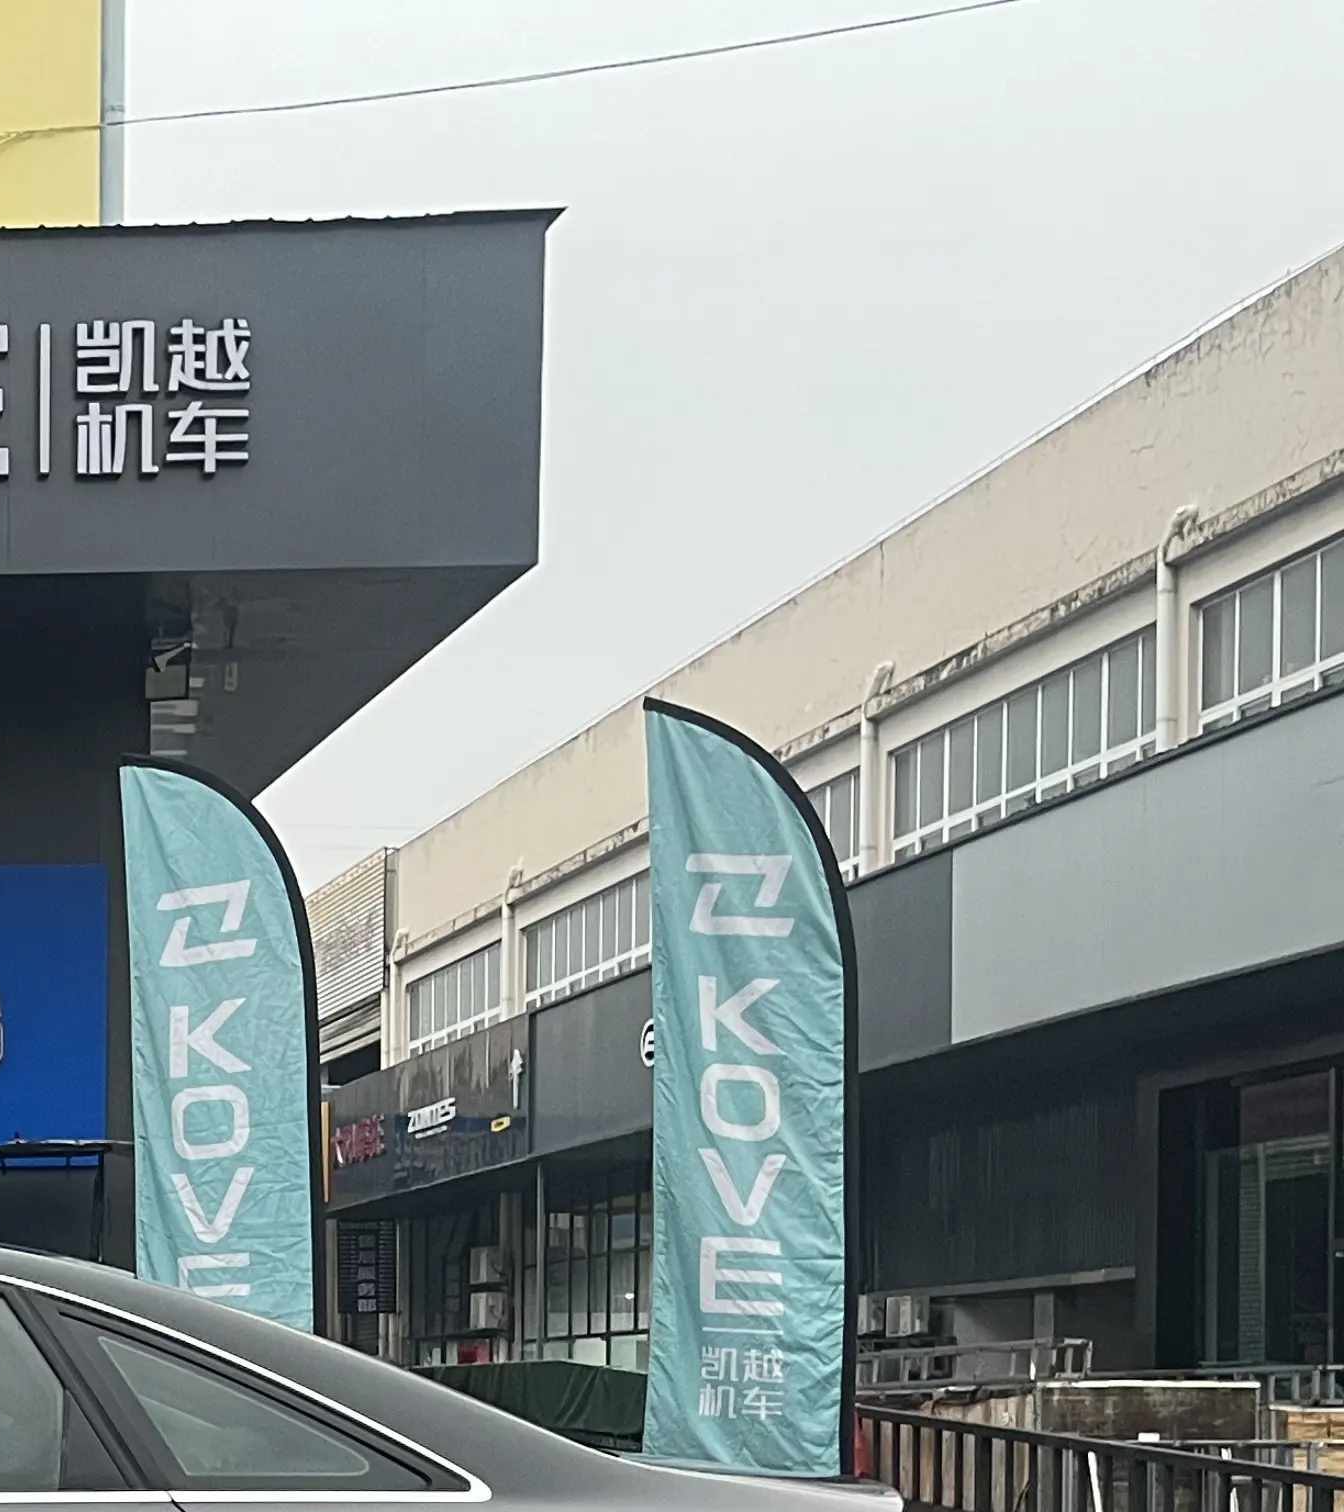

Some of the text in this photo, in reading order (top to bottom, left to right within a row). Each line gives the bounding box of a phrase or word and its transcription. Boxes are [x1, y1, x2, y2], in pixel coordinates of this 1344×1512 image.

[75, 318, 251, 394] 凯越
[75, 401, 250, 476] 机车
[698, 974, 787, 1317] KOVE
[701, 1345, 785, 1384] 凯越
[699, 1385, 783, 1421] 机车
